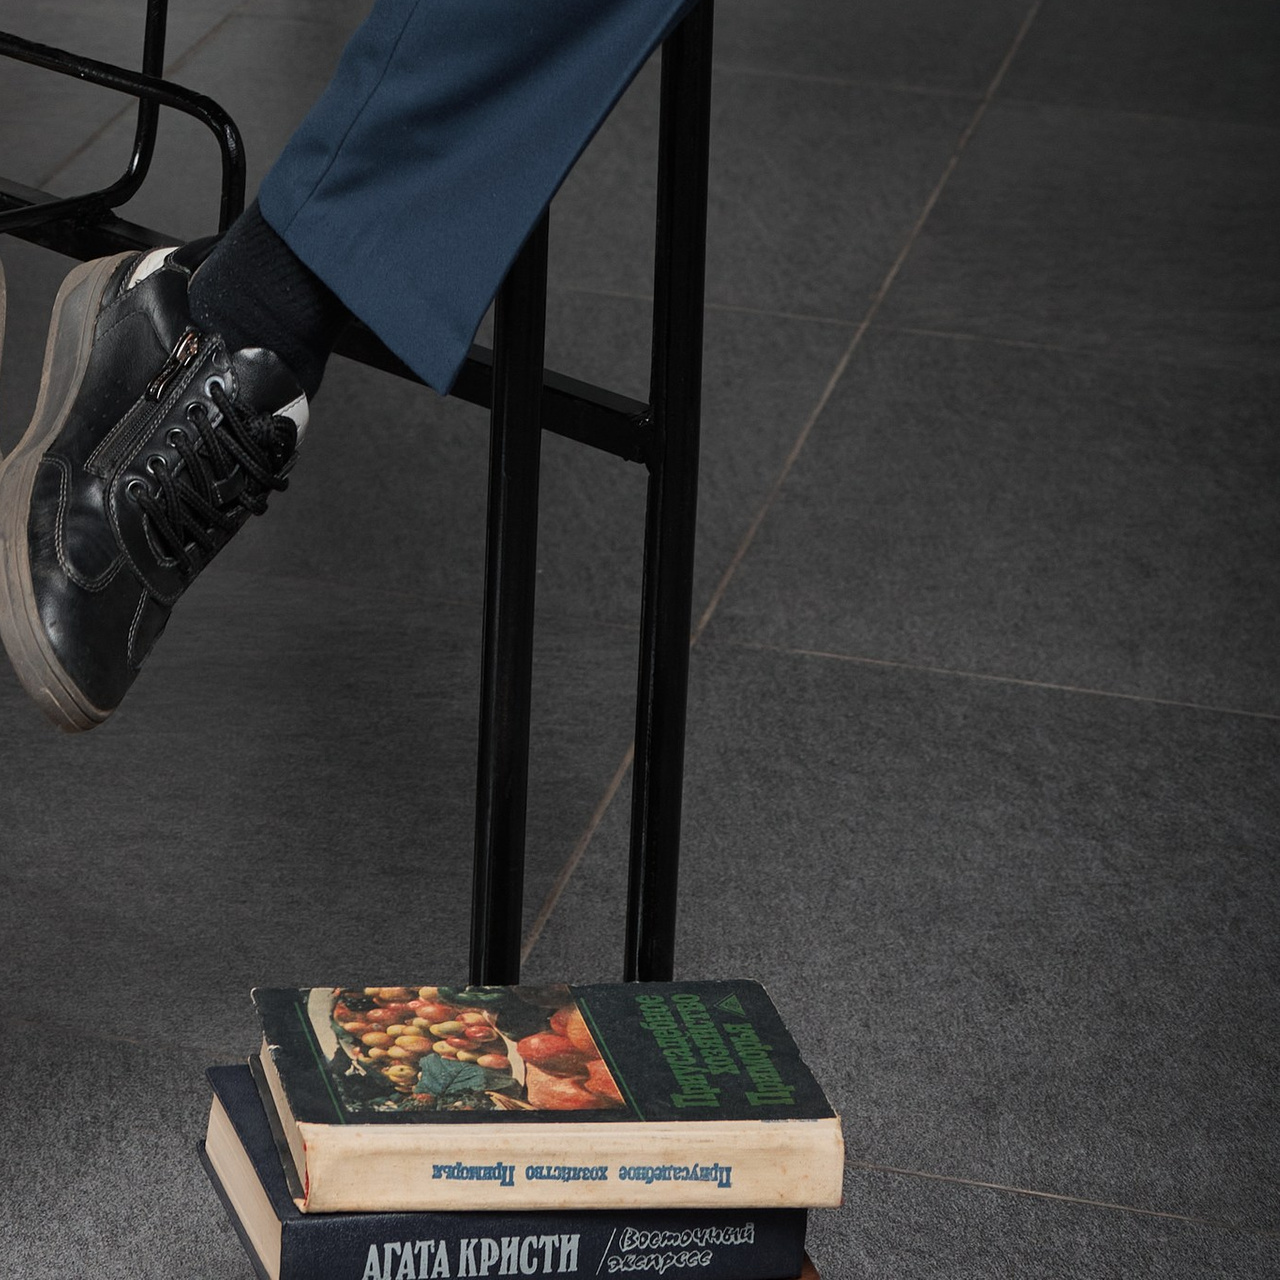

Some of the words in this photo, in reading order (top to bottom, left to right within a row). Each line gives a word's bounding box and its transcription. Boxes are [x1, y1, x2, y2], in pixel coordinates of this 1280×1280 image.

[634, 992, 722, 1109] Приусадебное
[670, 992, 741, 1076] хозяйство
[722, 1022, 797, 1107] Приморья
[431, 1160, 517, 1188] Приморья
[524, 1163, 609, 1184] хозяйство
[618, 1161, 733, 1190] Приусадебное
[361, 1239, 452, 1280] АГАТА
[456, 1233, 581, 1277] КРИСТИ
